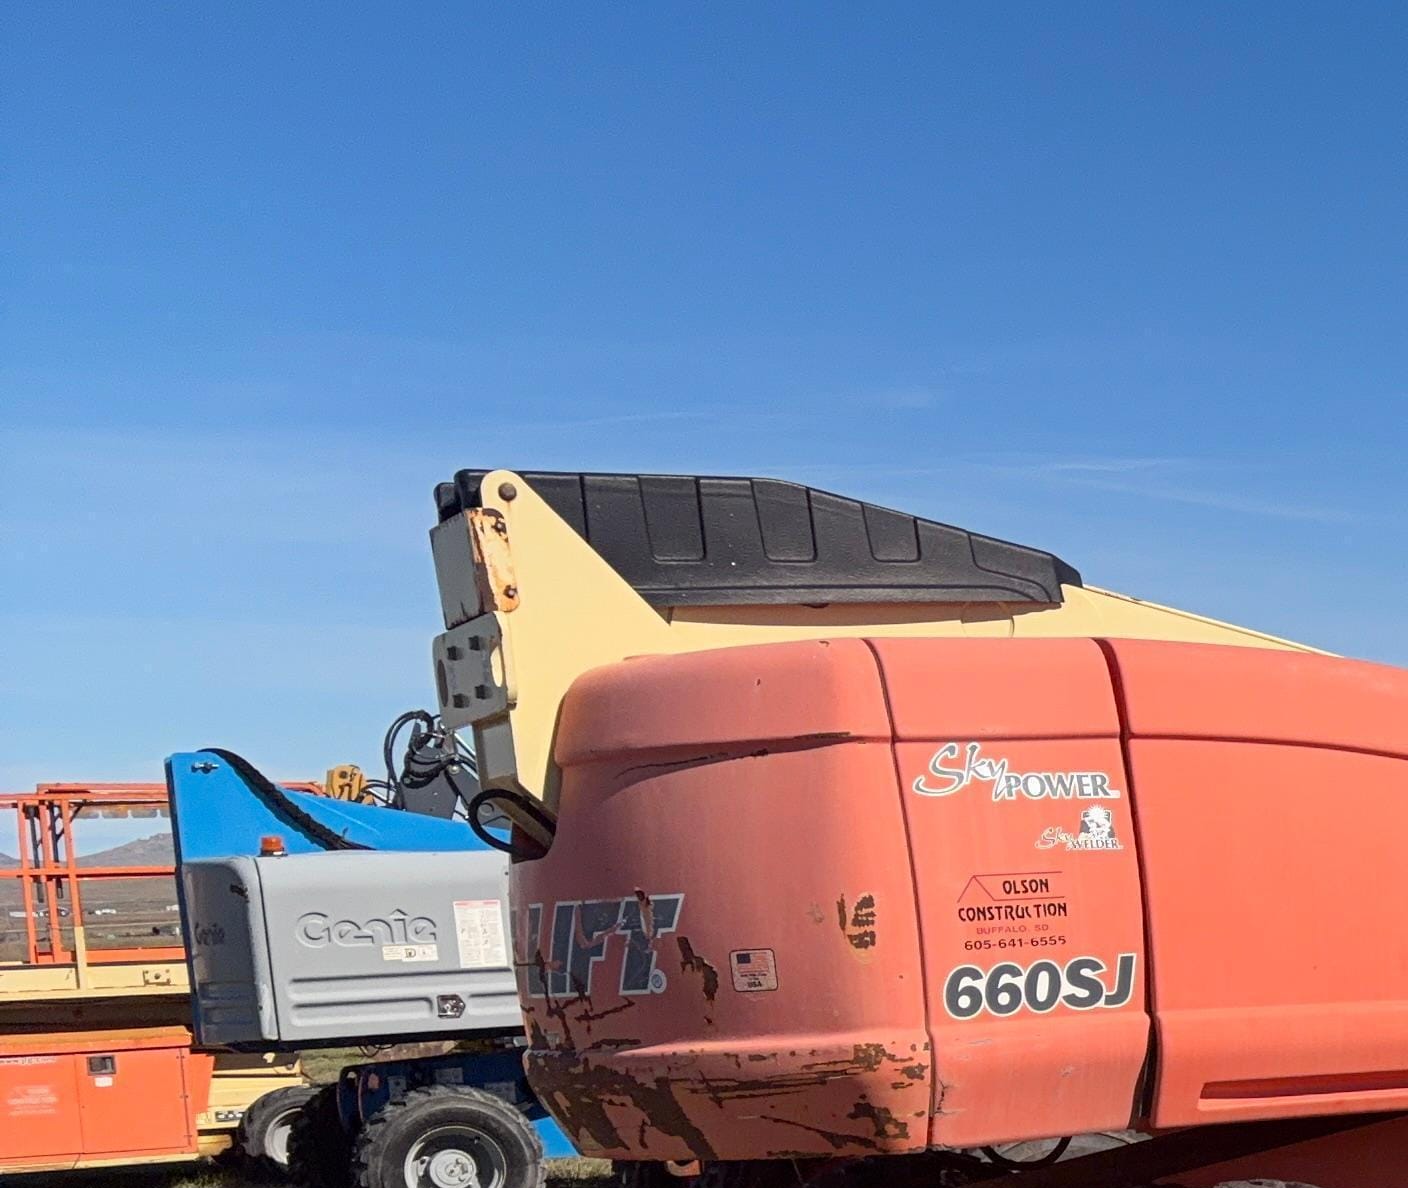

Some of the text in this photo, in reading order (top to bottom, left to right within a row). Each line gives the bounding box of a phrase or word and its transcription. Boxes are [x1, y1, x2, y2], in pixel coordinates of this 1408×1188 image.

[1002, 878, 1050, 895] OLSON
[296, 908, 437, 949] Genie
[964, 935, 1067, 951] 605-641-6555
[944, 954, 1136, 1019] 660SJ
